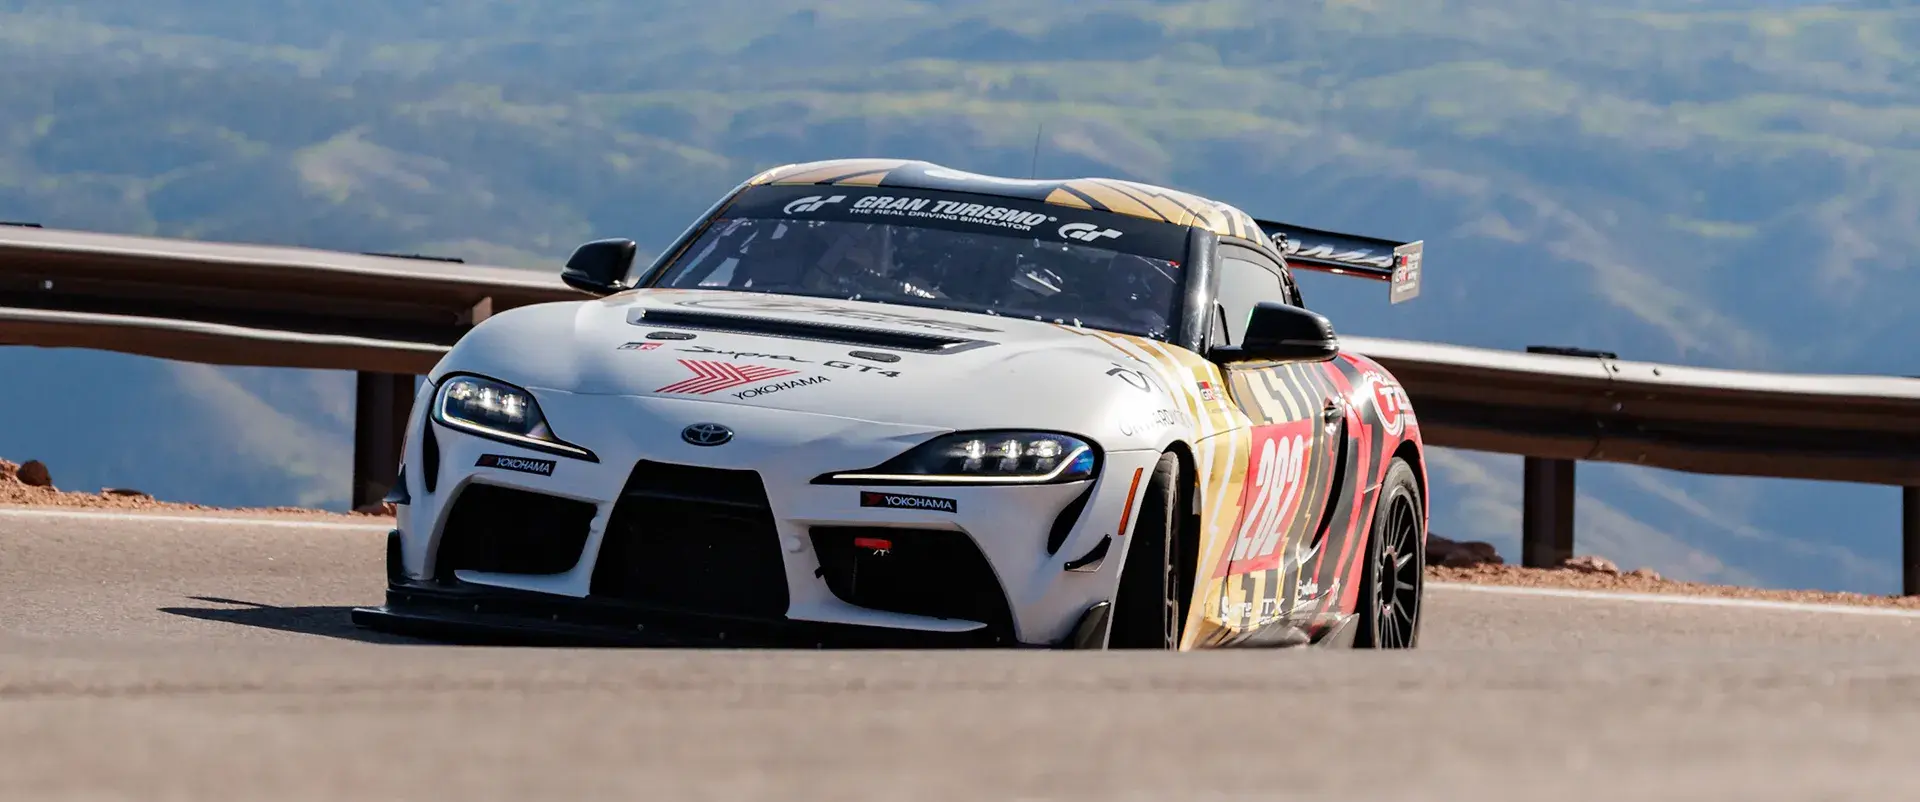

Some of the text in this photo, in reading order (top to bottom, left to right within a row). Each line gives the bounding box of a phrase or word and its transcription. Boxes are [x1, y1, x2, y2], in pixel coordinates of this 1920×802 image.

[853, 195, 931, 211] GRAN
[873, 209, 906, 217] REAL
[906, 210, 958, 221] DRIVING
[959, 215, 1032, 231] SIMULATOR
[674, 345, 901, 378] Supra GT4
[732, 375, 831, 400] YOKOHAMA
[496, 457, 550, 473] YOKOHAMA
[885, 495, 953, 510] YOKOHAMA
[1227, 434, 1304, 561] 282
